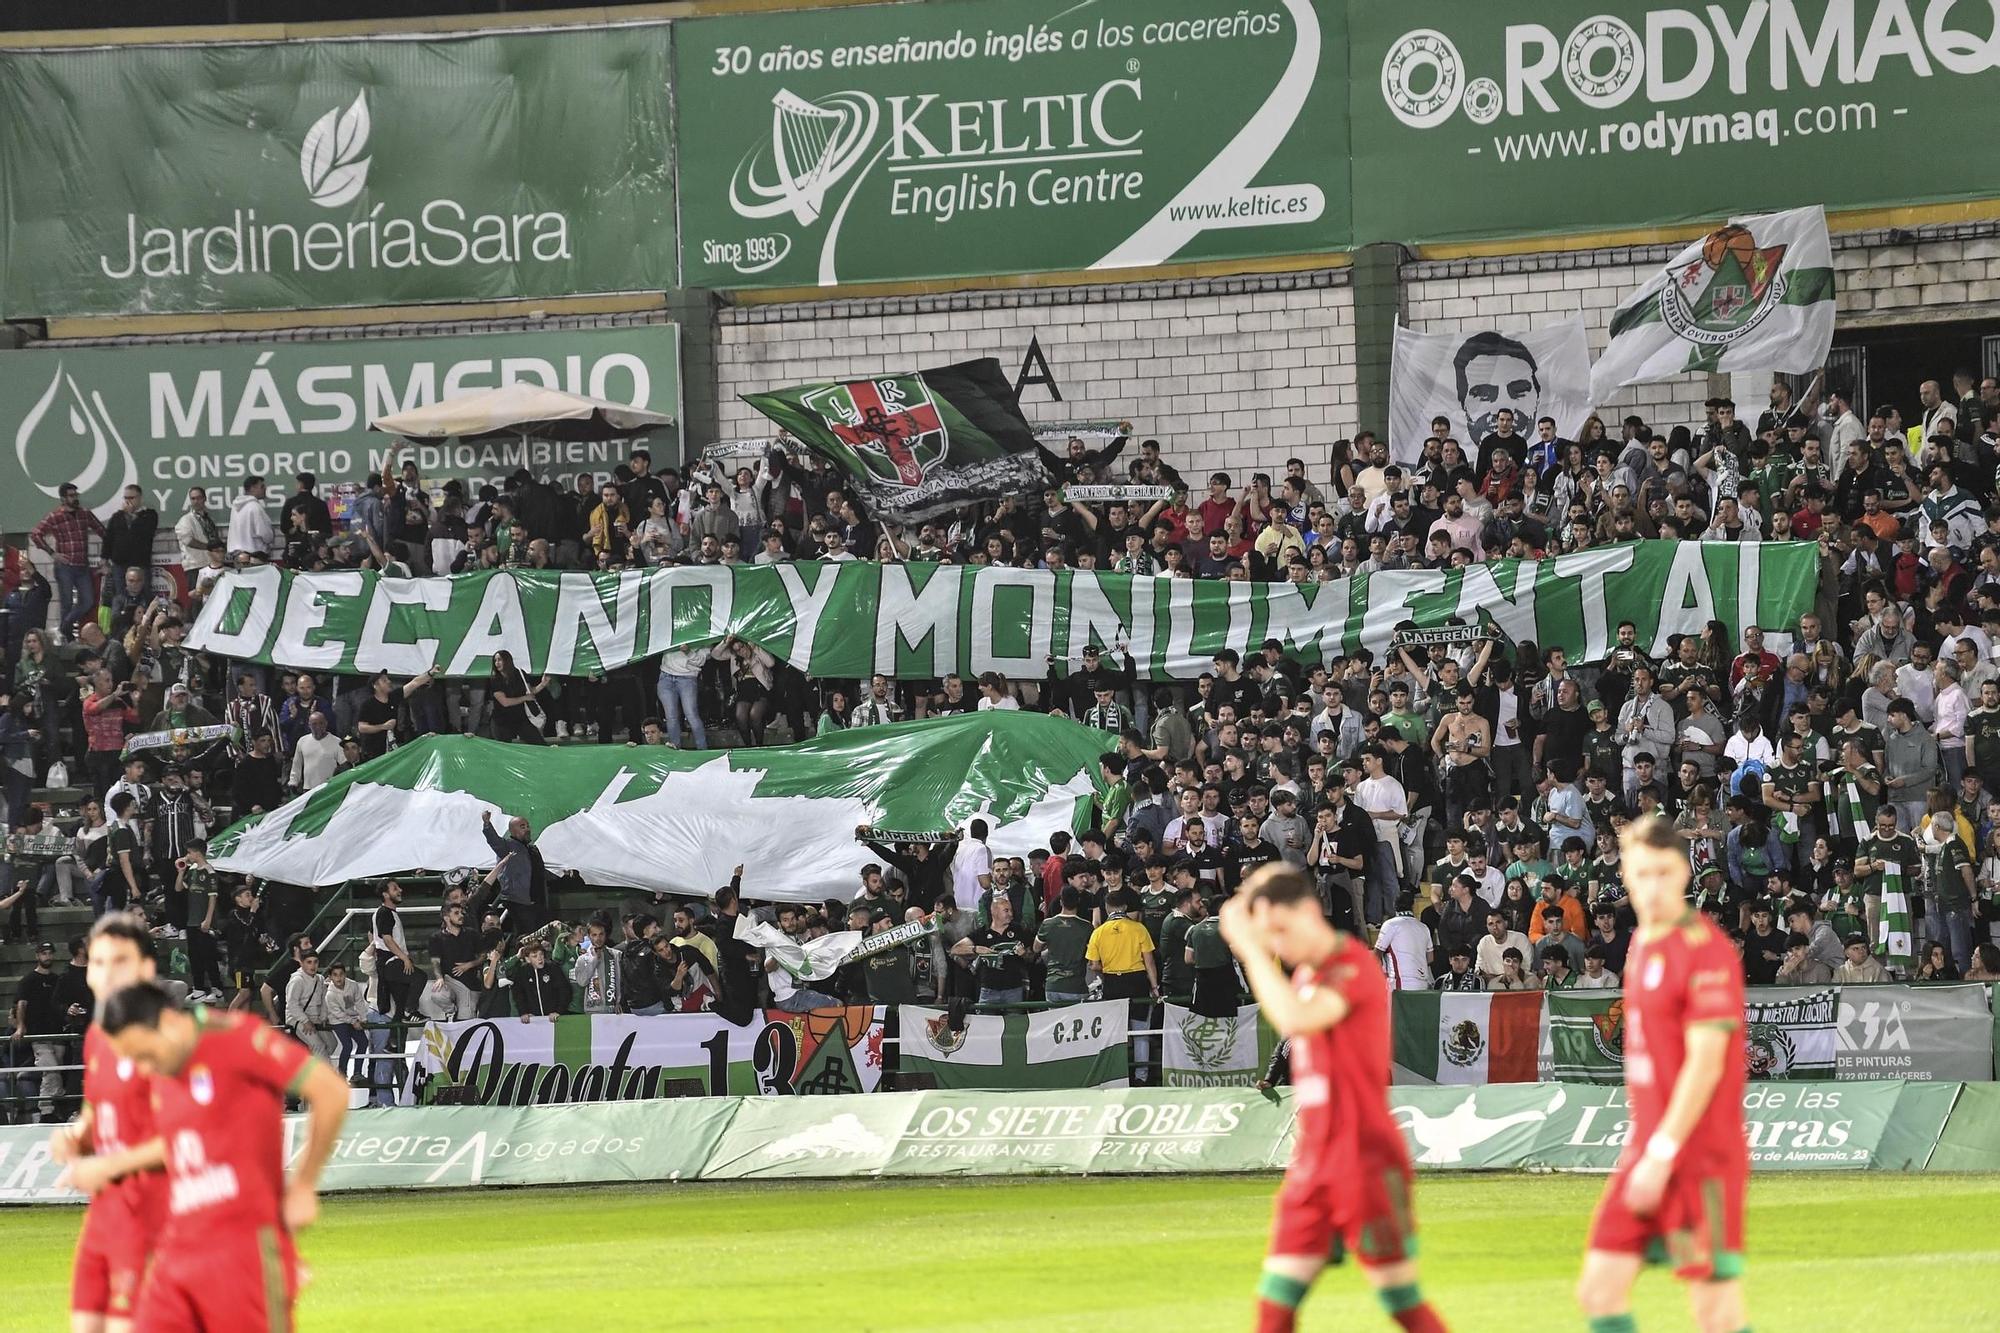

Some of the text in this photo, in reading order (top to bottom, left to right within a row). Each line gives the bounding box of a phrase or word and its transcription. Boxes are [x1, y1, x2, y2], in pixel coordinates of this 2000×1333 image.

[711, 11, 1281, 76] 30 años enseñando inglés a los cacereños
[1506, 0, 2000, 118] RODYMAQ
[885, 77, 1144, 162] KELTIC
[1495, 100, 1877, 163] www.rodymaq.com
[889, 167, 1145, 222] English Centre
[1169, 193, 1309, 223] www.keltic.es
[101, 199, 572, 280] JardineríaSara
[702, 236, 776, 265] Since 1993
[1014, 333, 1063, 402] A
[152, 437, 650, 480] CONSORCIO MEDIOAMBIENTE
[152, 488, 173, 512] Y
[182, 540, 1793, 680] DECANO Y MONUMENTAL
[1401, 624, 1482, 644] CACEREÑO
[1762, 1003, 1799, 1024] NUESTRA
[1053, 1016, 1102, 1045] C.P.C
[1837, 1055, 1913, 1068] DE PINTURAS
[1887, 1070, 1933, 1081] CÁCERES
[1795, 1087, 1843, 1109] las
[902, 1102, 1246, 1137] LOS SIETE ROBLES
[906, 1142, 1056, 1159] RESTAURANTE
[1089, 1140, 1123, 1157] 927
[1764, 1151, 1782, 1161] de
[1783, 1150, 1849, 1163] Alemania,
[1852, 1150, 1868, 1160] 23
